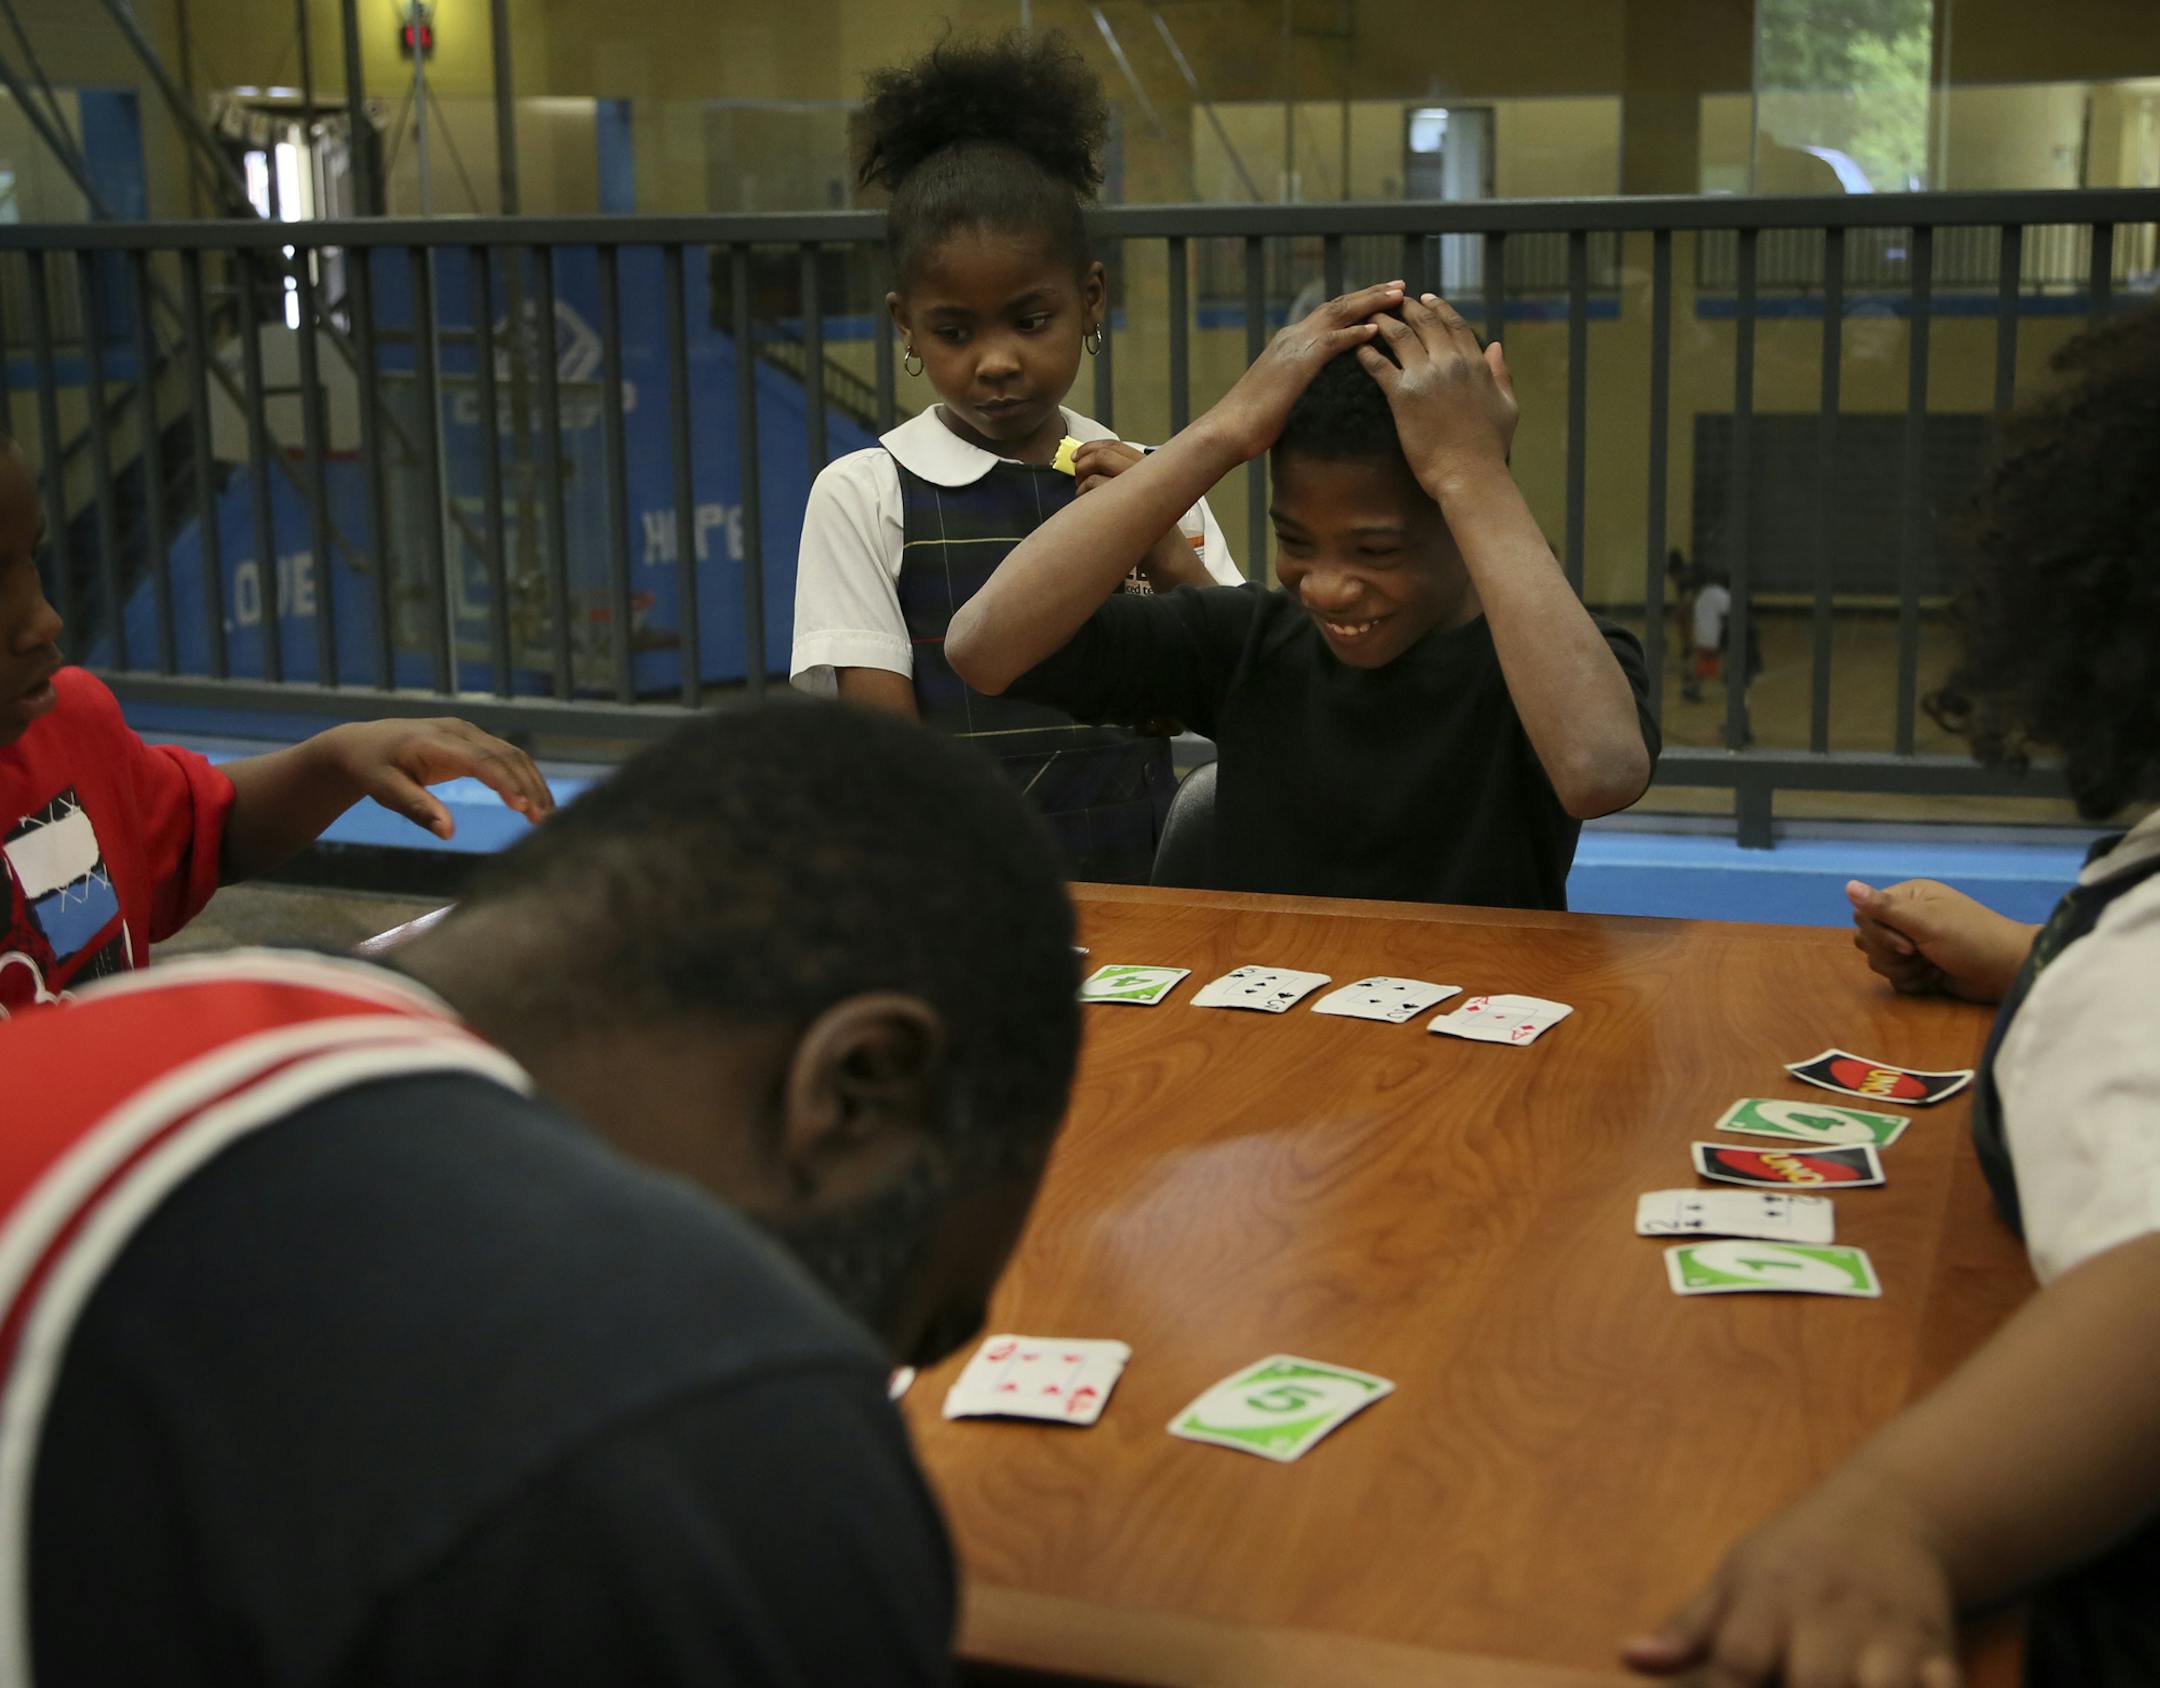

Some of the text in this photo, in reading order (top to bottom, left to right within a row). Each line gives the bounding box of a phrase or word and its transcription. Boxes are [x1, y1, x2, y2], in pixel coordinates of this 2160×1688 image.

[1110, 976, 1153, 987] 4
[1858, 1069, 1903, 1097] UNO
[1786, 1112, 1846, 1131] 4
[1759, 1152, 1824, 1184] UNO
[1245, 1383, 1326, 1413] 5
